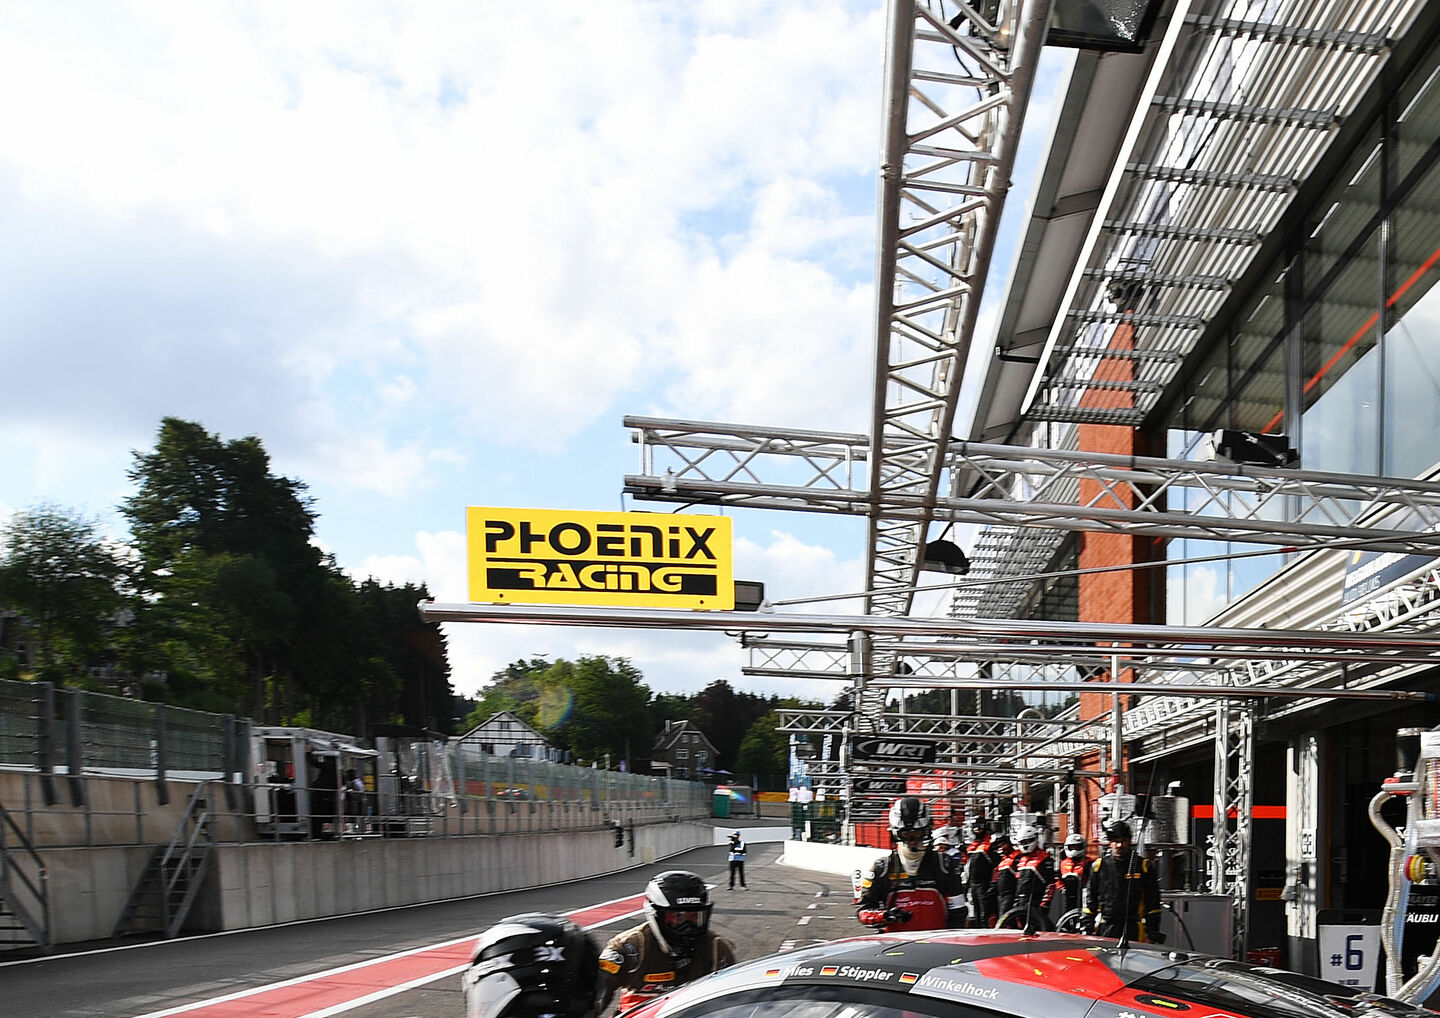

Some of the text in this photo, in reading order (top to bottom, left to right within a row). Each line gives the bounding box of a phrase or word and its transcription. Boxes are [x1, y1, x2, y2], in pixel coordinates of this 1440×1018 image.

[485, 520, 717, 560] PHOENIX
[518, 562, 683, 593] RACING
[1406, 911, 1440, 923] ÄUBLI
[1329, 934, 1364, 971] #6
[783, 965, 814, 978] Mies
[838, 965, 894, 982] Stippler
[919, 974, 1001, 1001] Winkelhock
